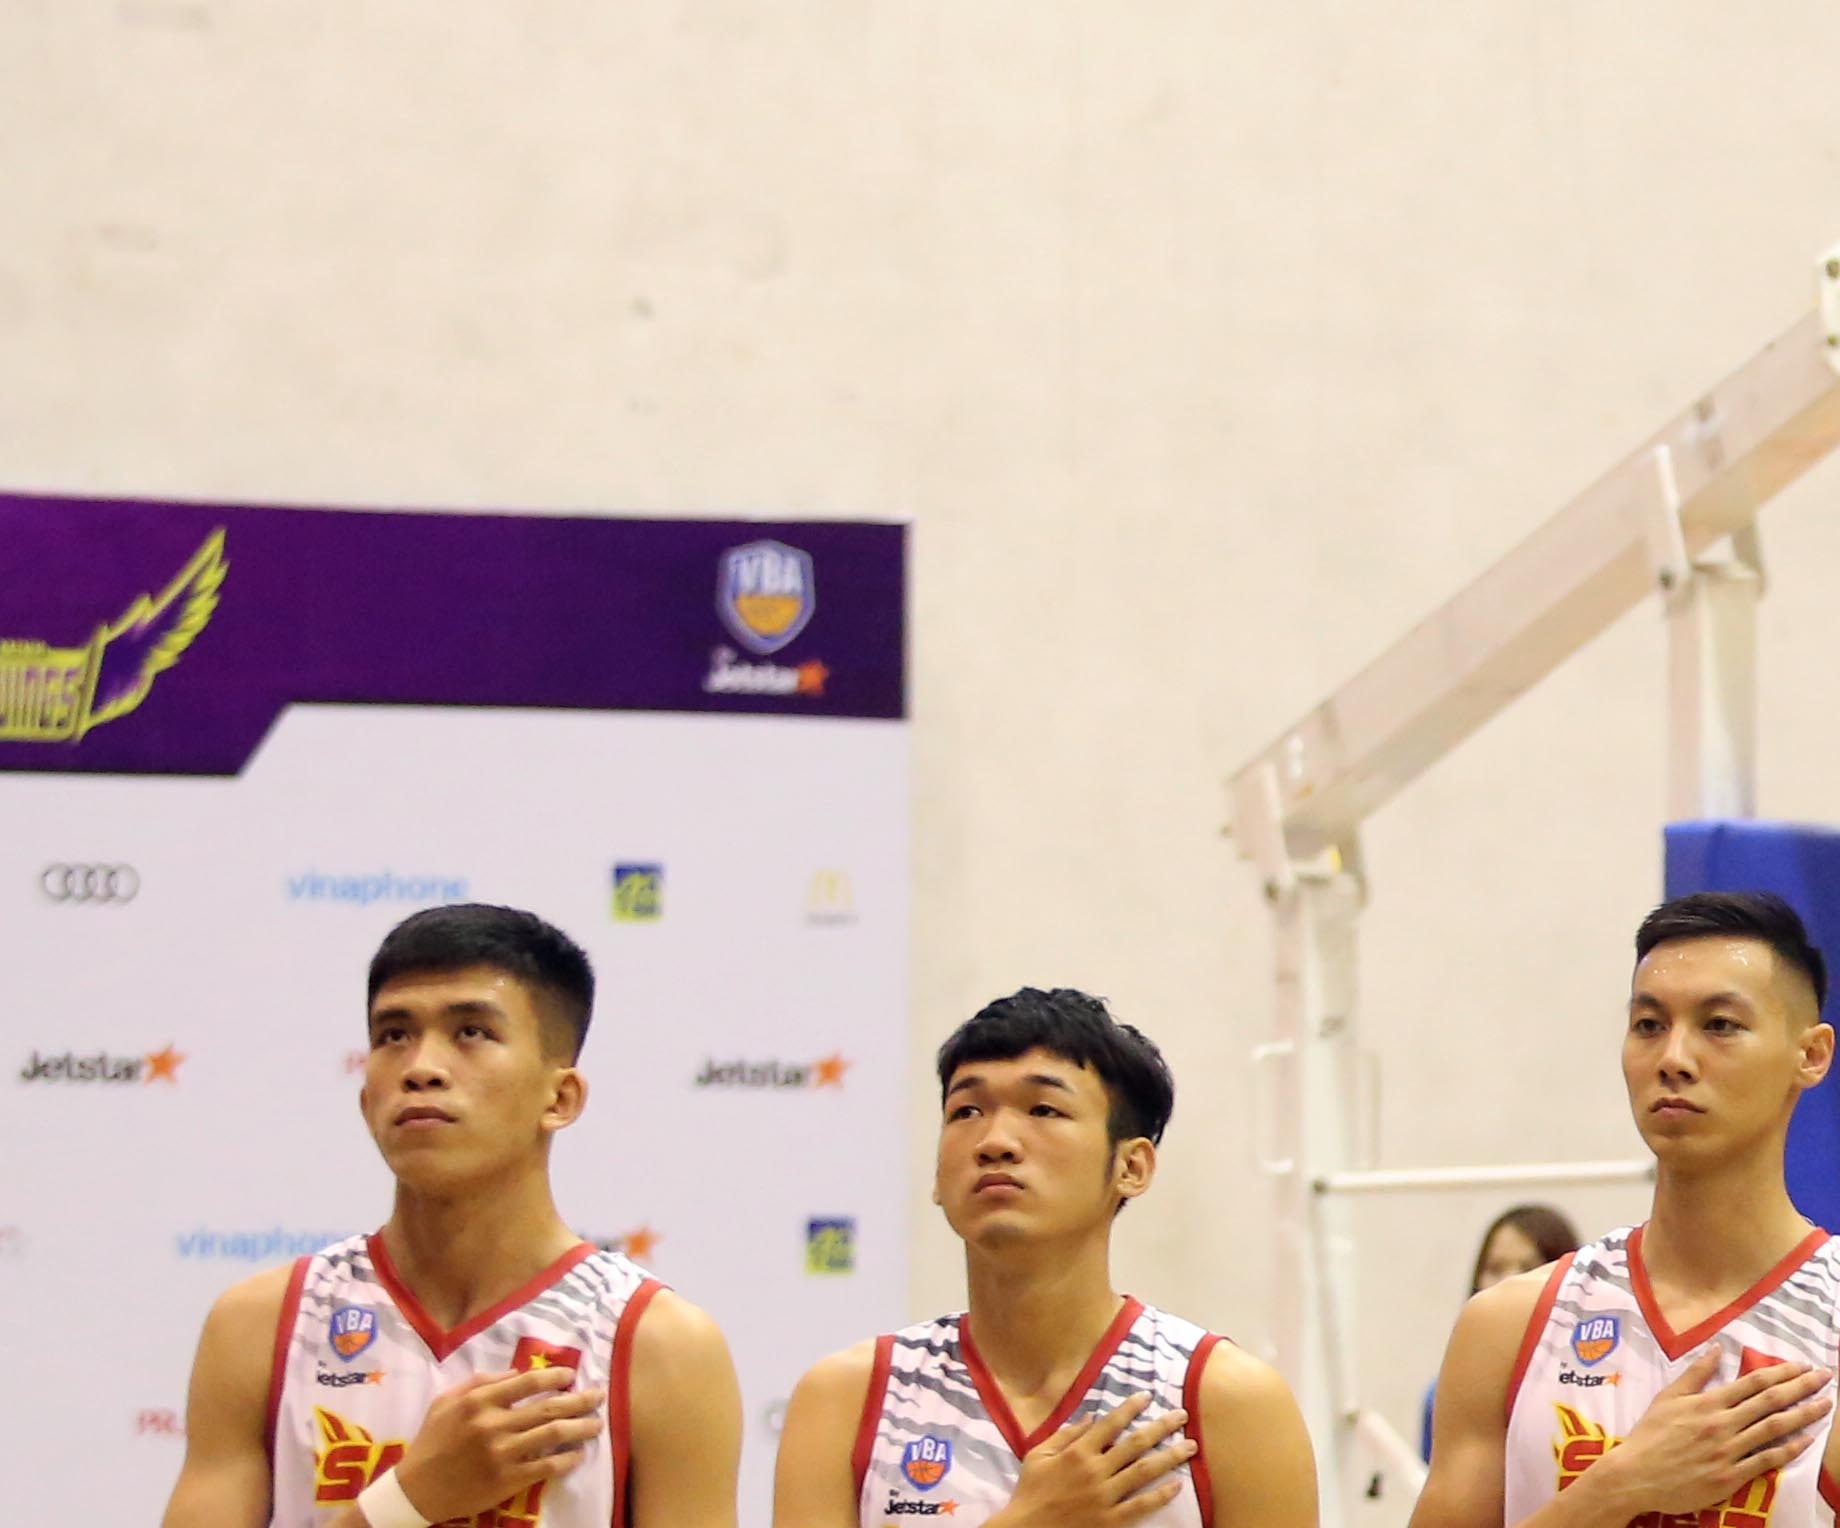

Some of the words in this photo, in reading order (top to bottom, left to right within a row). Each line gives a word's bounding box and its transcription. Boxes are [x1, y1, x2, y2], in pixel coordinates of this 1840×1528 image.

[286, 868, 469, 905] vinaphone
[19, 1051, 142, 1083] Jetstar
[696, 1057, 809, 1087] Jetstar
[1580, 1319, 1614, 1341] VBA
[911, 1439, 947, 1462] VBA
